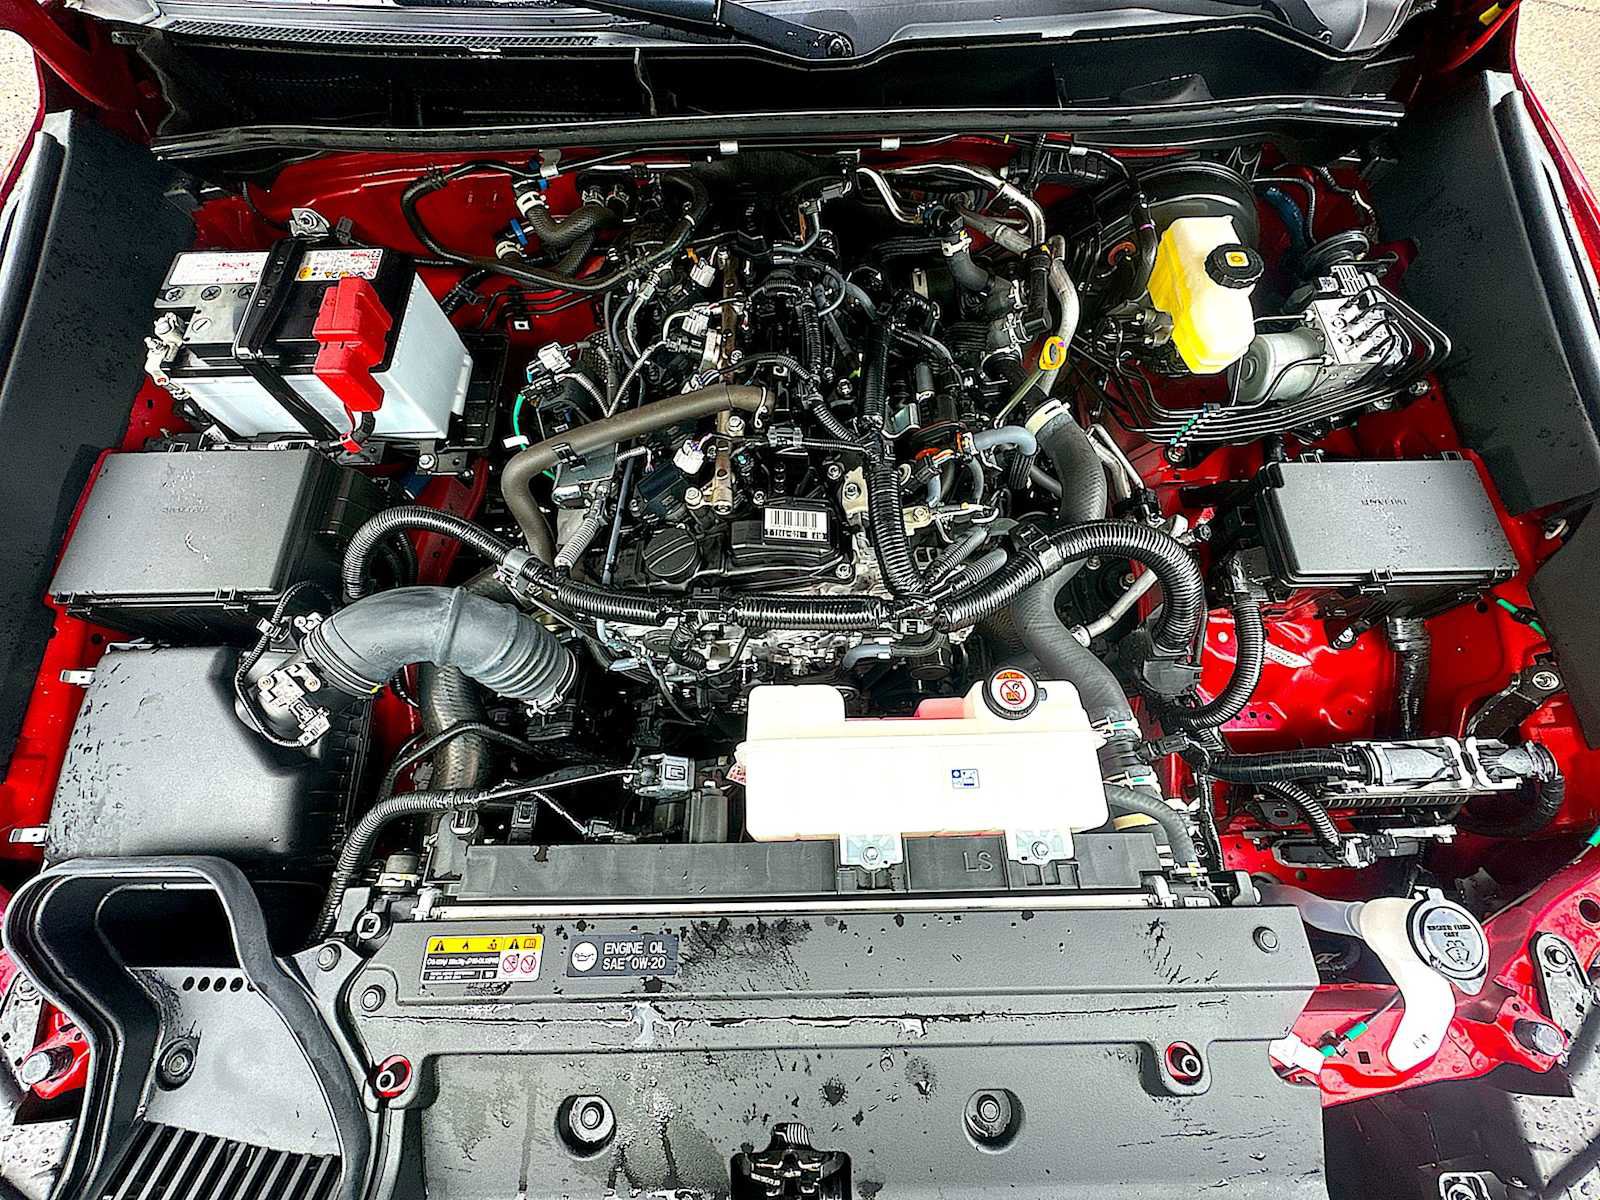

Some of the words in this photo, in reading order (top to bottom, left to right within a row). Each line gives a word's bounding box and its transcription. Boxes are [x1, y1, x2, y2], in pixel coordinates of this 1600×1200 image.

[962, 851, 993, 872] LS
[603, 942, 644, 955] ENGINE
[649, 941, 667, 954] OIL
[602, 957, 625, 970] SAE
[631, 956, 666, 970] 0W-20
